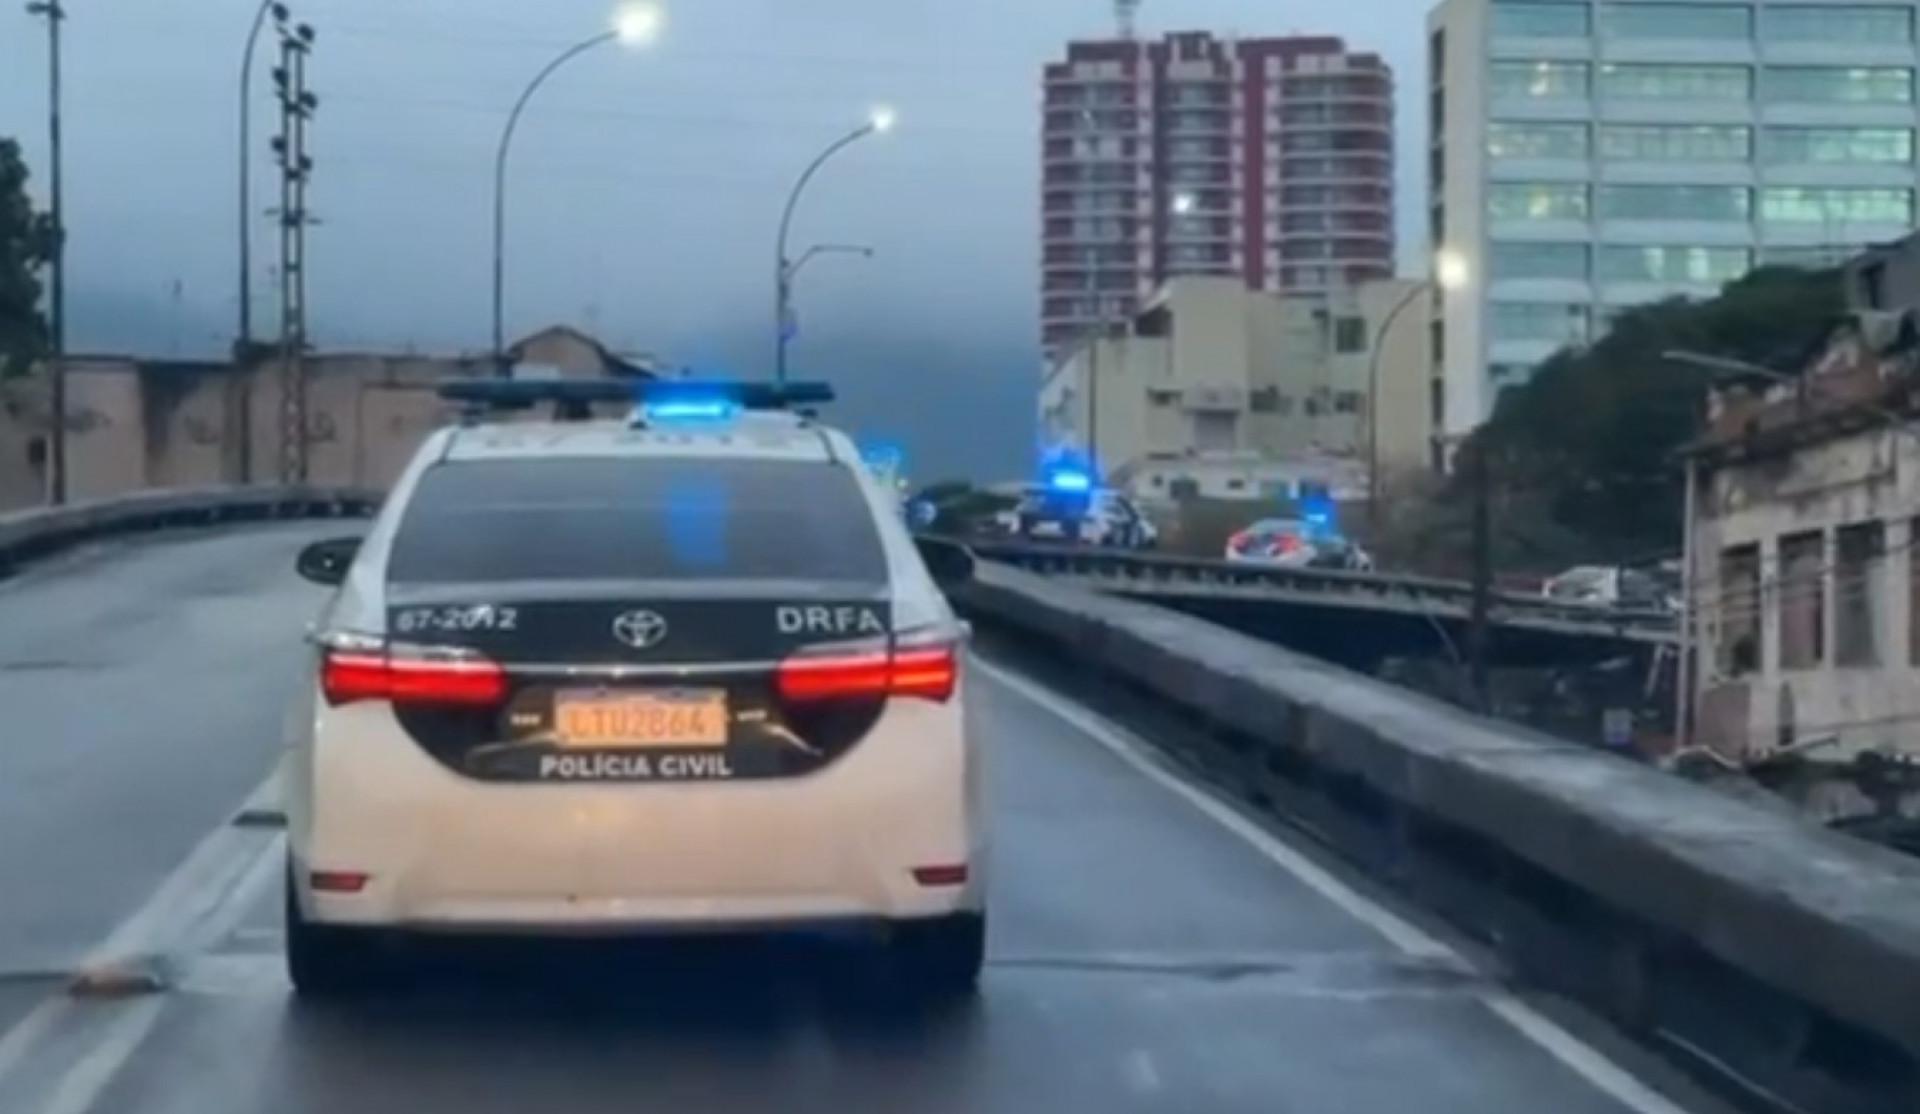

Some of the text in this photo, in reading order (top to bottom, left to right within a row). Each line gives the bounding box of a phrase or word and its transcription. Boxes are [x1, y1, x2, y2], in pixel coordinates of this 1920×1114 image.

[776, 605, 883, 633] DRFA
[540, 752, 733, 777] POLÍCIA CIVIL
